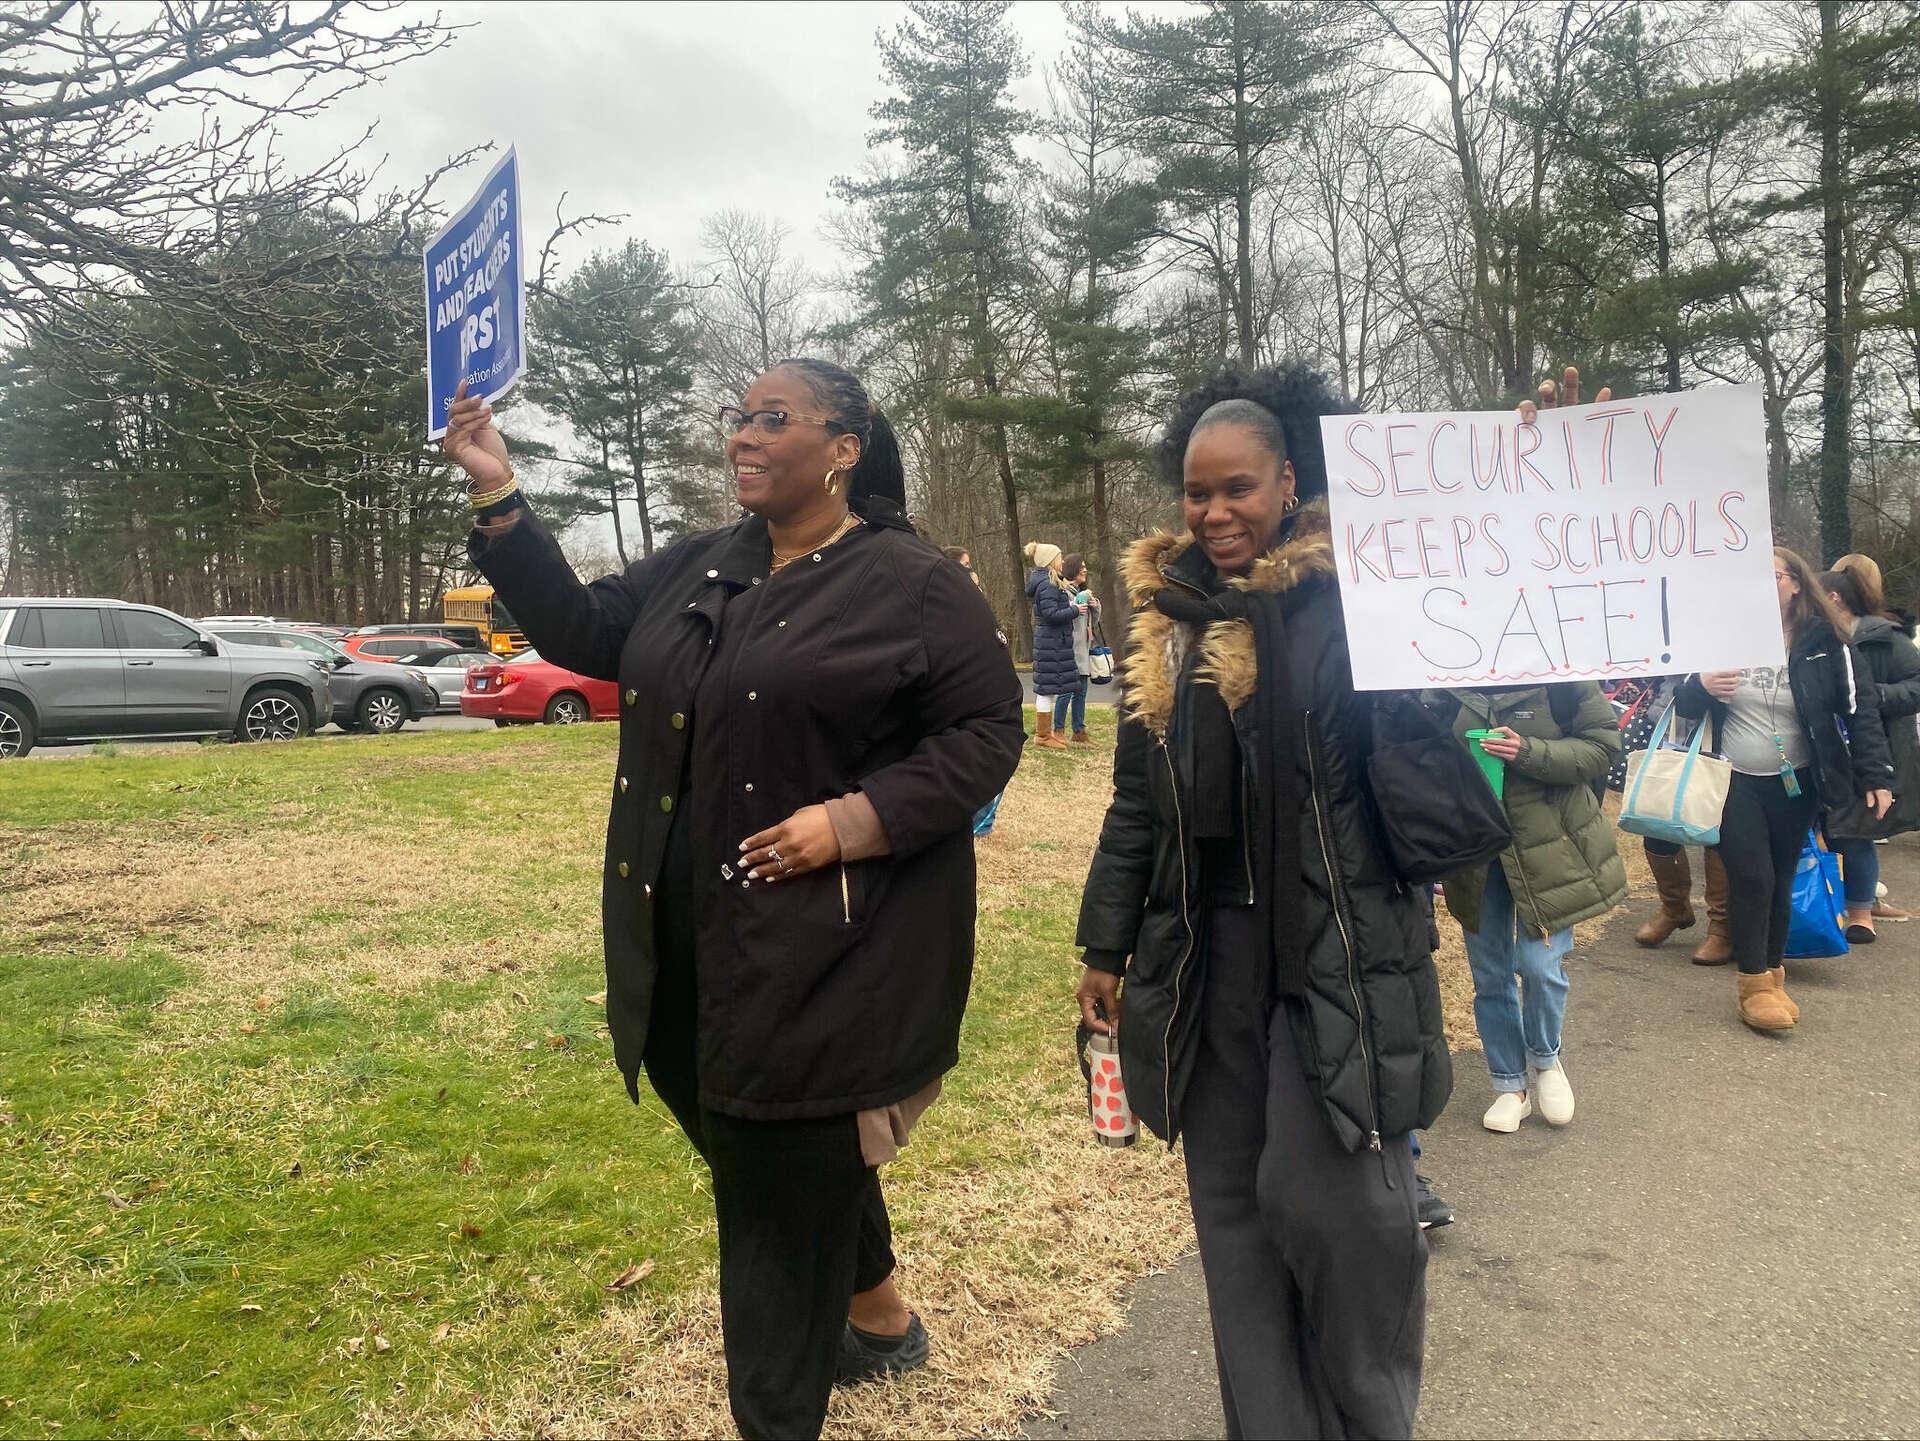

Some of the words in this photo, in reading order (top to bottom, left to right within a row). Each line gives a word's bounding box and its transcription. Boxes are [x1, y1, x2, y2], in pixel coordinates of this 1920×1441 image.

[435, 249, 459, 292] PUT
[459, 188, 508, 272] STUDENTS
[436, 288, 464, 333] AND
[463, 231, 511, 308] EACHERS
[1344, 406, 1679, 498] SECURITY
[1347, 512, 1510, 584] KEEPS
[1530, 491, 1749, 575] SCHOOLS
[1411, 576, 1671, 674] SAFE!
